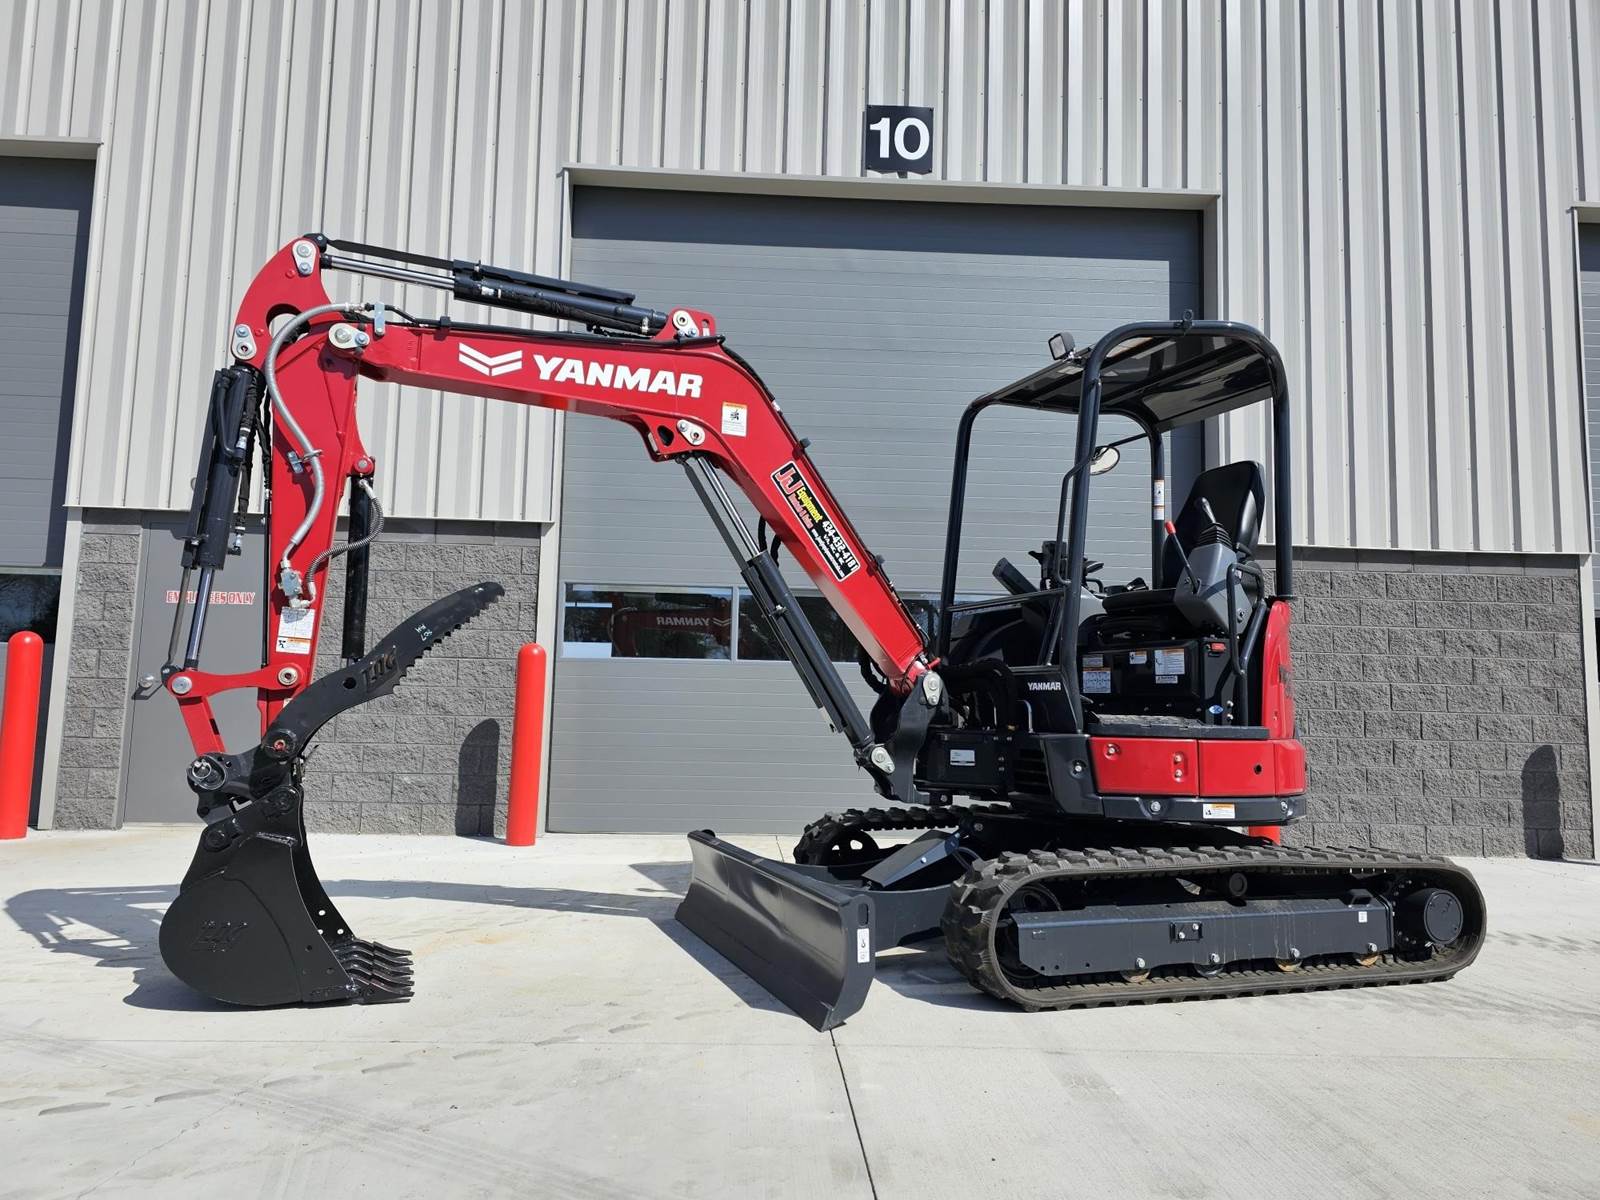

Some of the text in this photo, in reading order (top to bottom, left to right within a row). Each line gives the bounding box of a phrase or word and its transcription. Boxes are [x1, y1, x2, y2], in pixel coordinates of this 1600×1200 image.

[869, 117, 930, 160] 10
[533, 353, 704, 398] YANMAR
[796, 487, 823, 523] Equipment
[227, 591, 255, 605] ONLY
[1027, 681, 1061, 691] YANMAR
